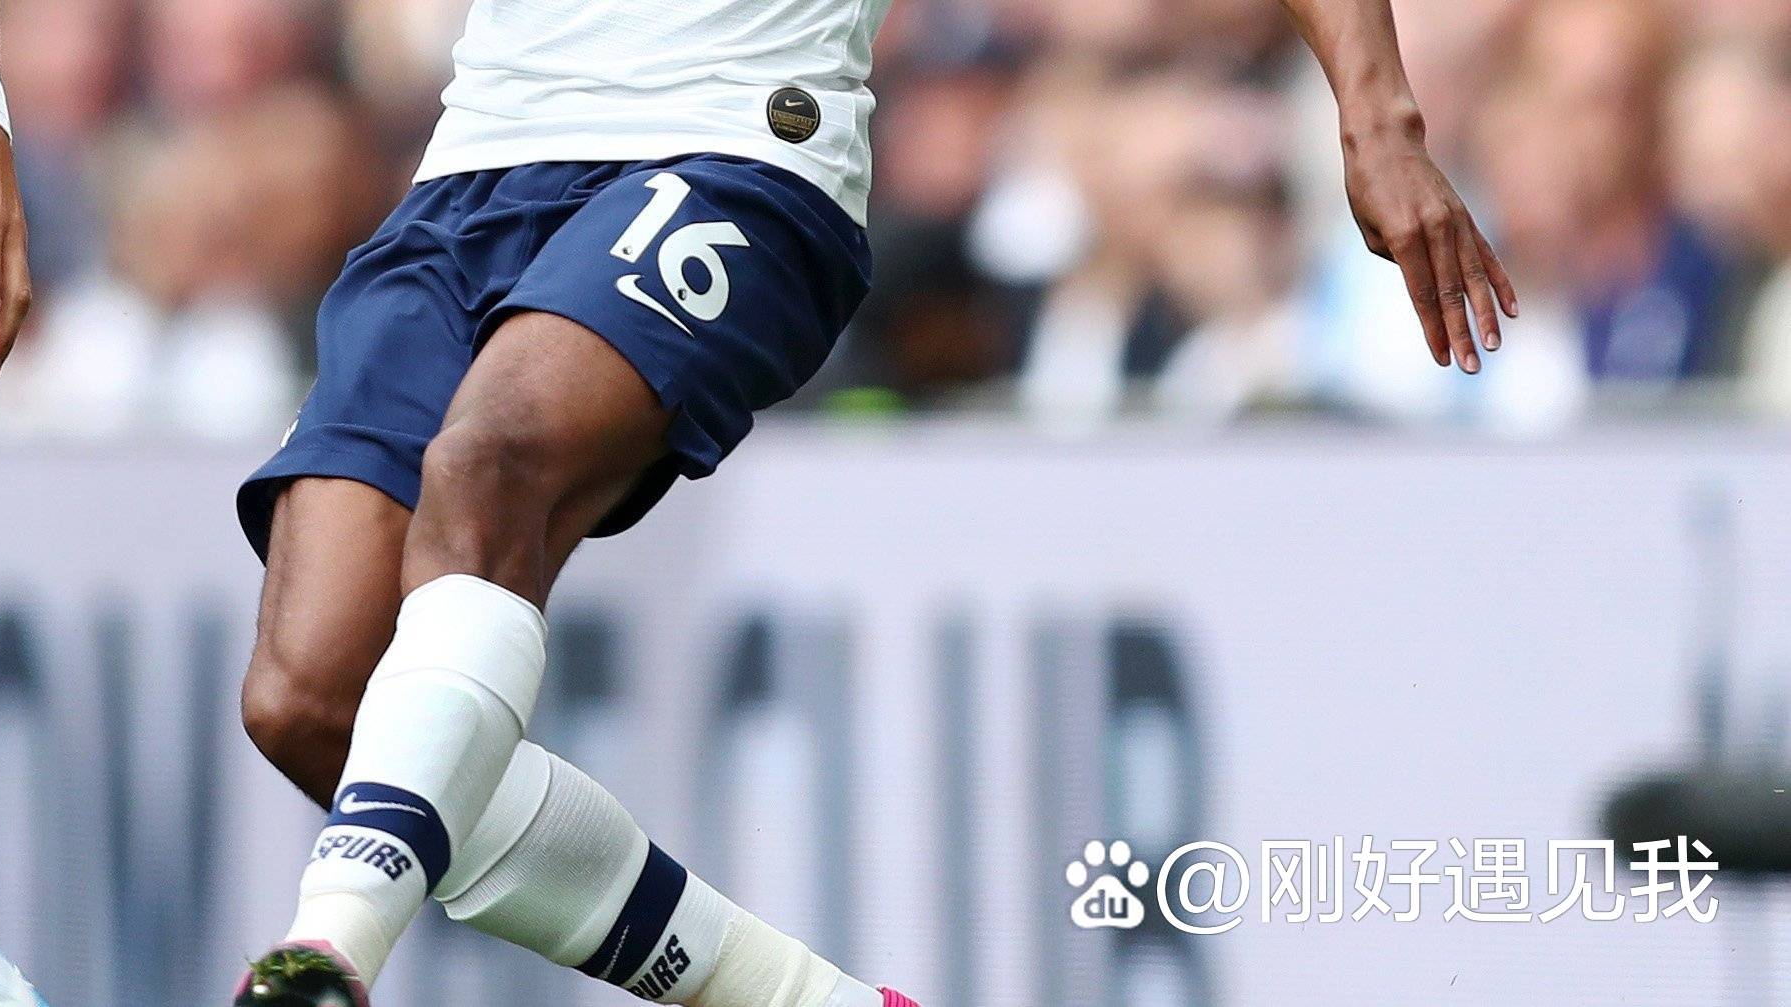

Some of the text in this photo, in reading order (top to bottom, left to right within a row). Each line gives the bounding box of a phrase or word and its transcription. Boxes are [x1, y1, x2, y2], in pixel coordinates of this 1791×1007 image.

[609, 172, 750, 322] 16
[319, 834, 412, 881] SPURS
[628, 934, 691, 999] PURS
